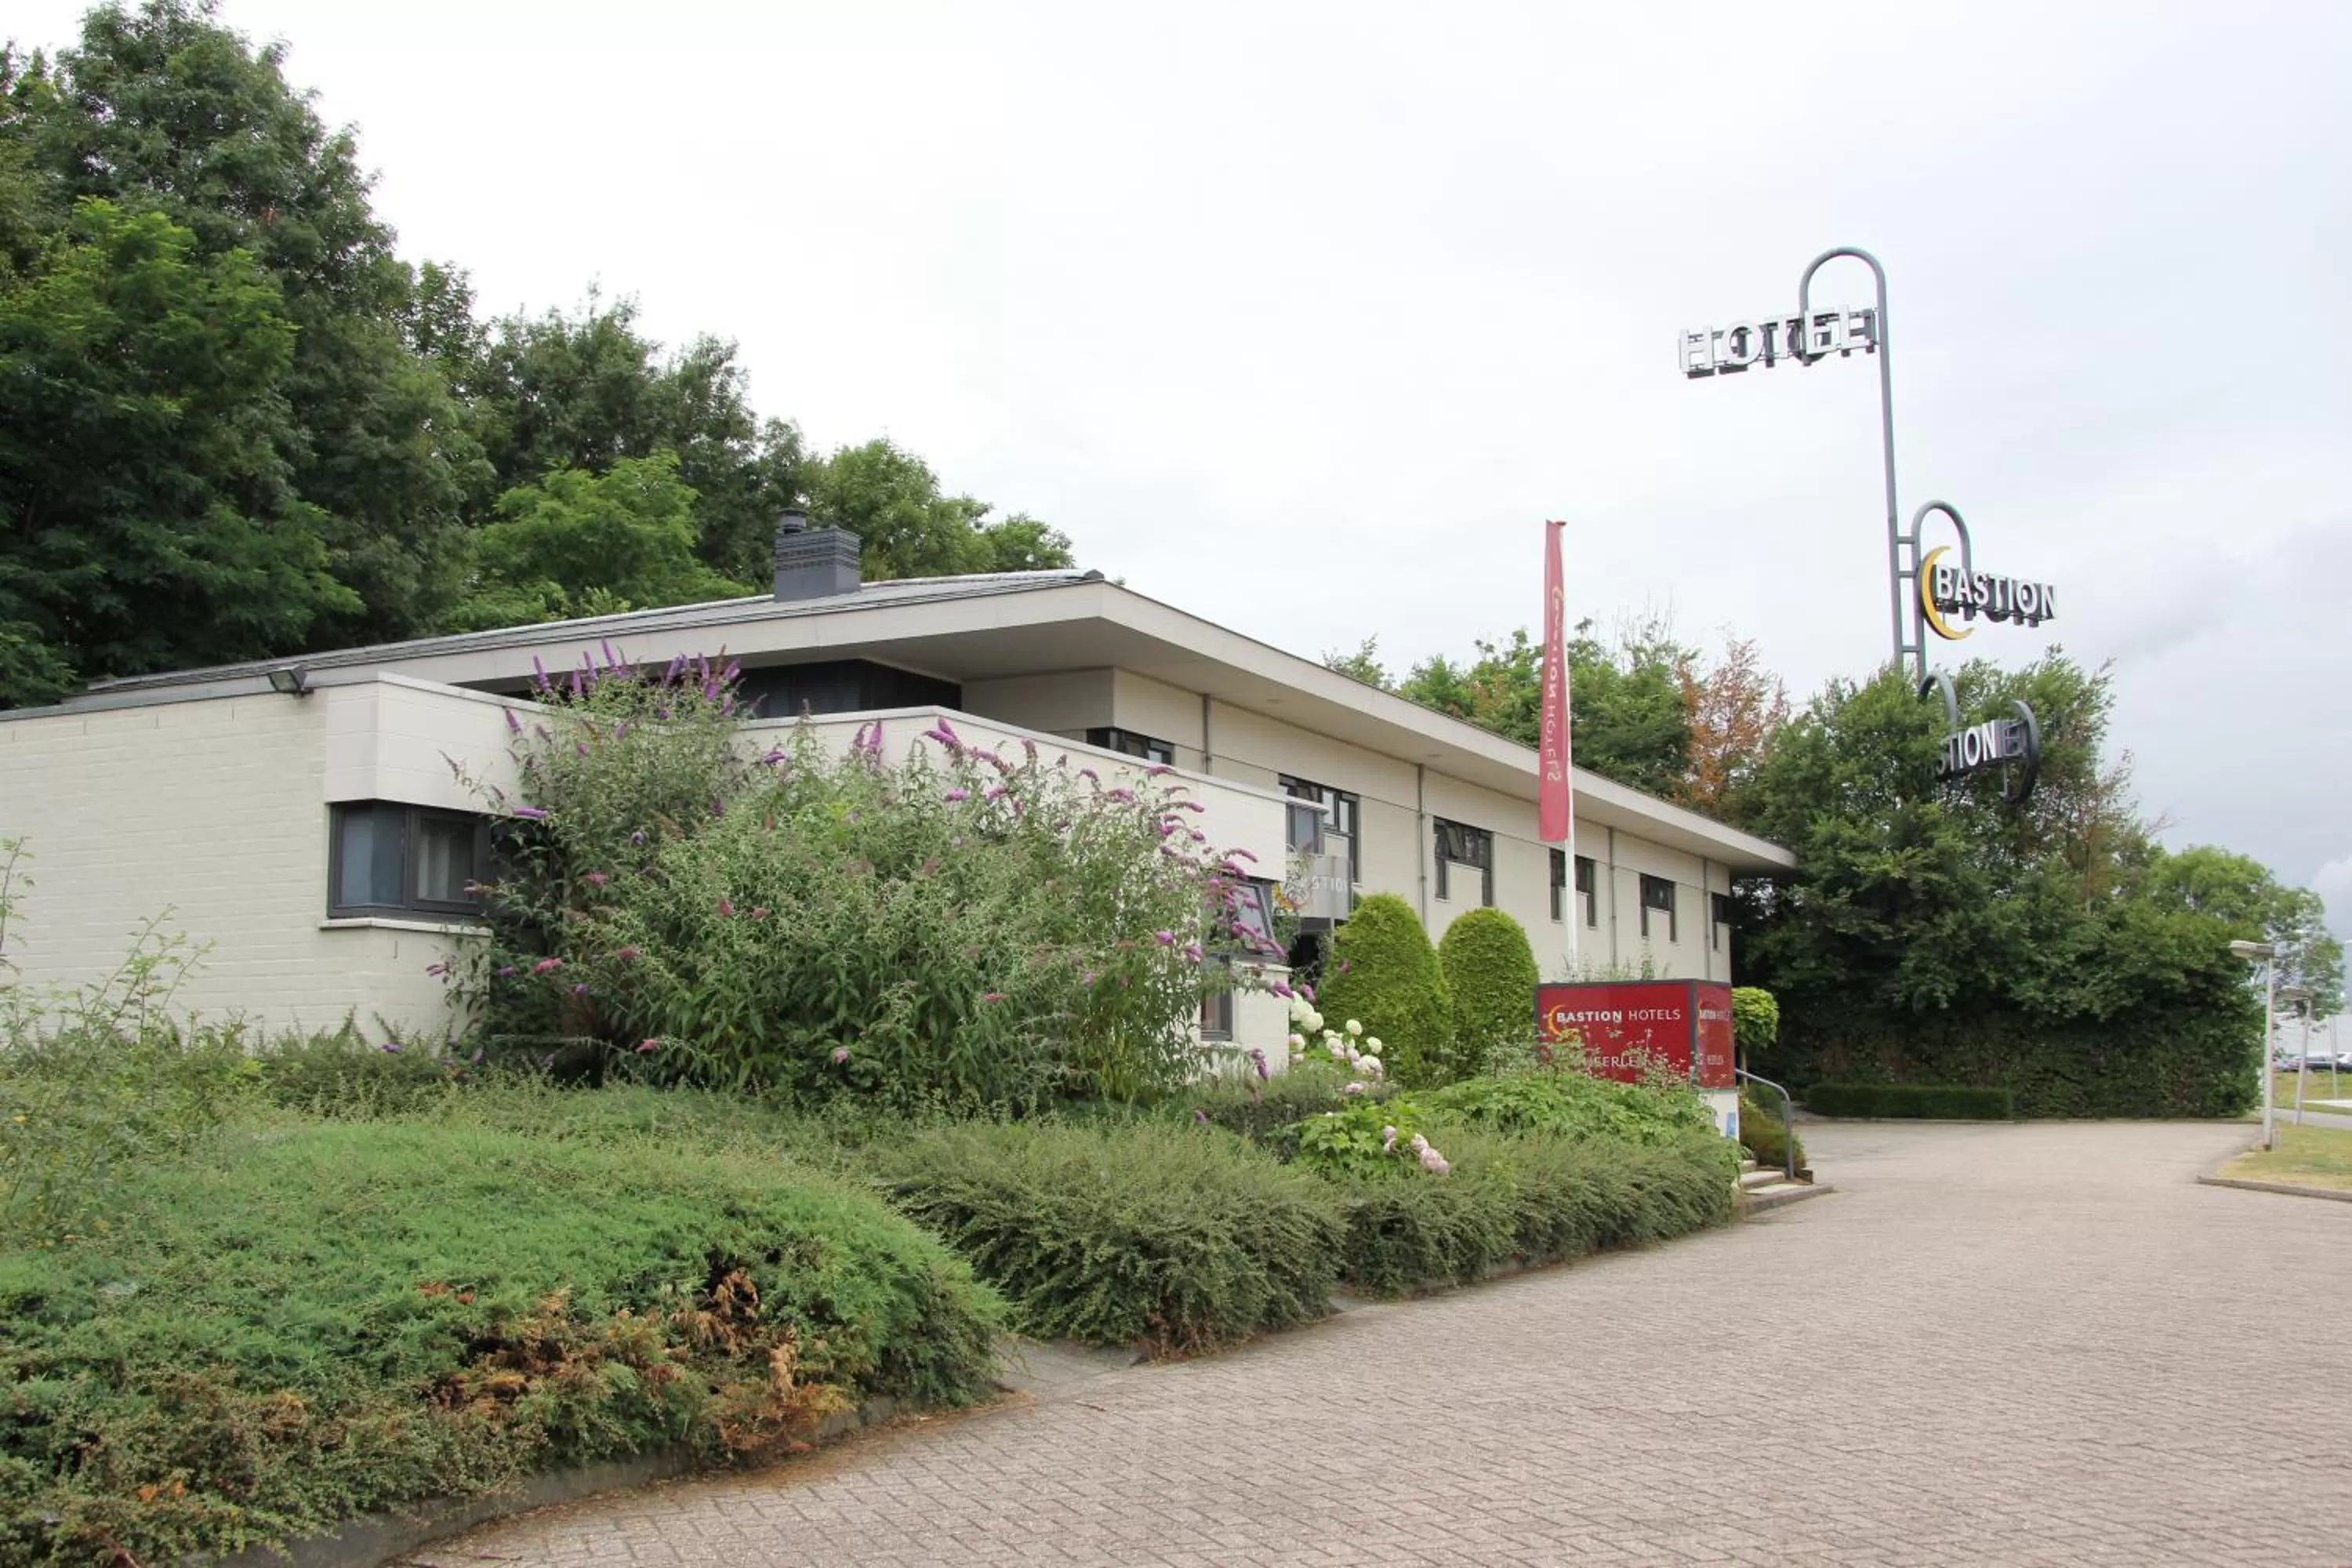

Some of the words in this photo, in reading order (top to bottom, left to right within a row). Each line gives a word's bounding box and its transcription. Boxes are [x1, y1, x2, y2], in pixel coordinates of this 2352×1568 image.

[1679, 304, 1878, 373] HOTEL
[1936, 564, 2057, 619] BASTION
[1925, 720, 1997, 777] STION
[1556, 1011, 1622, 1023] BASTION
[1628, 1009, 1681, 1020] HOTELS
